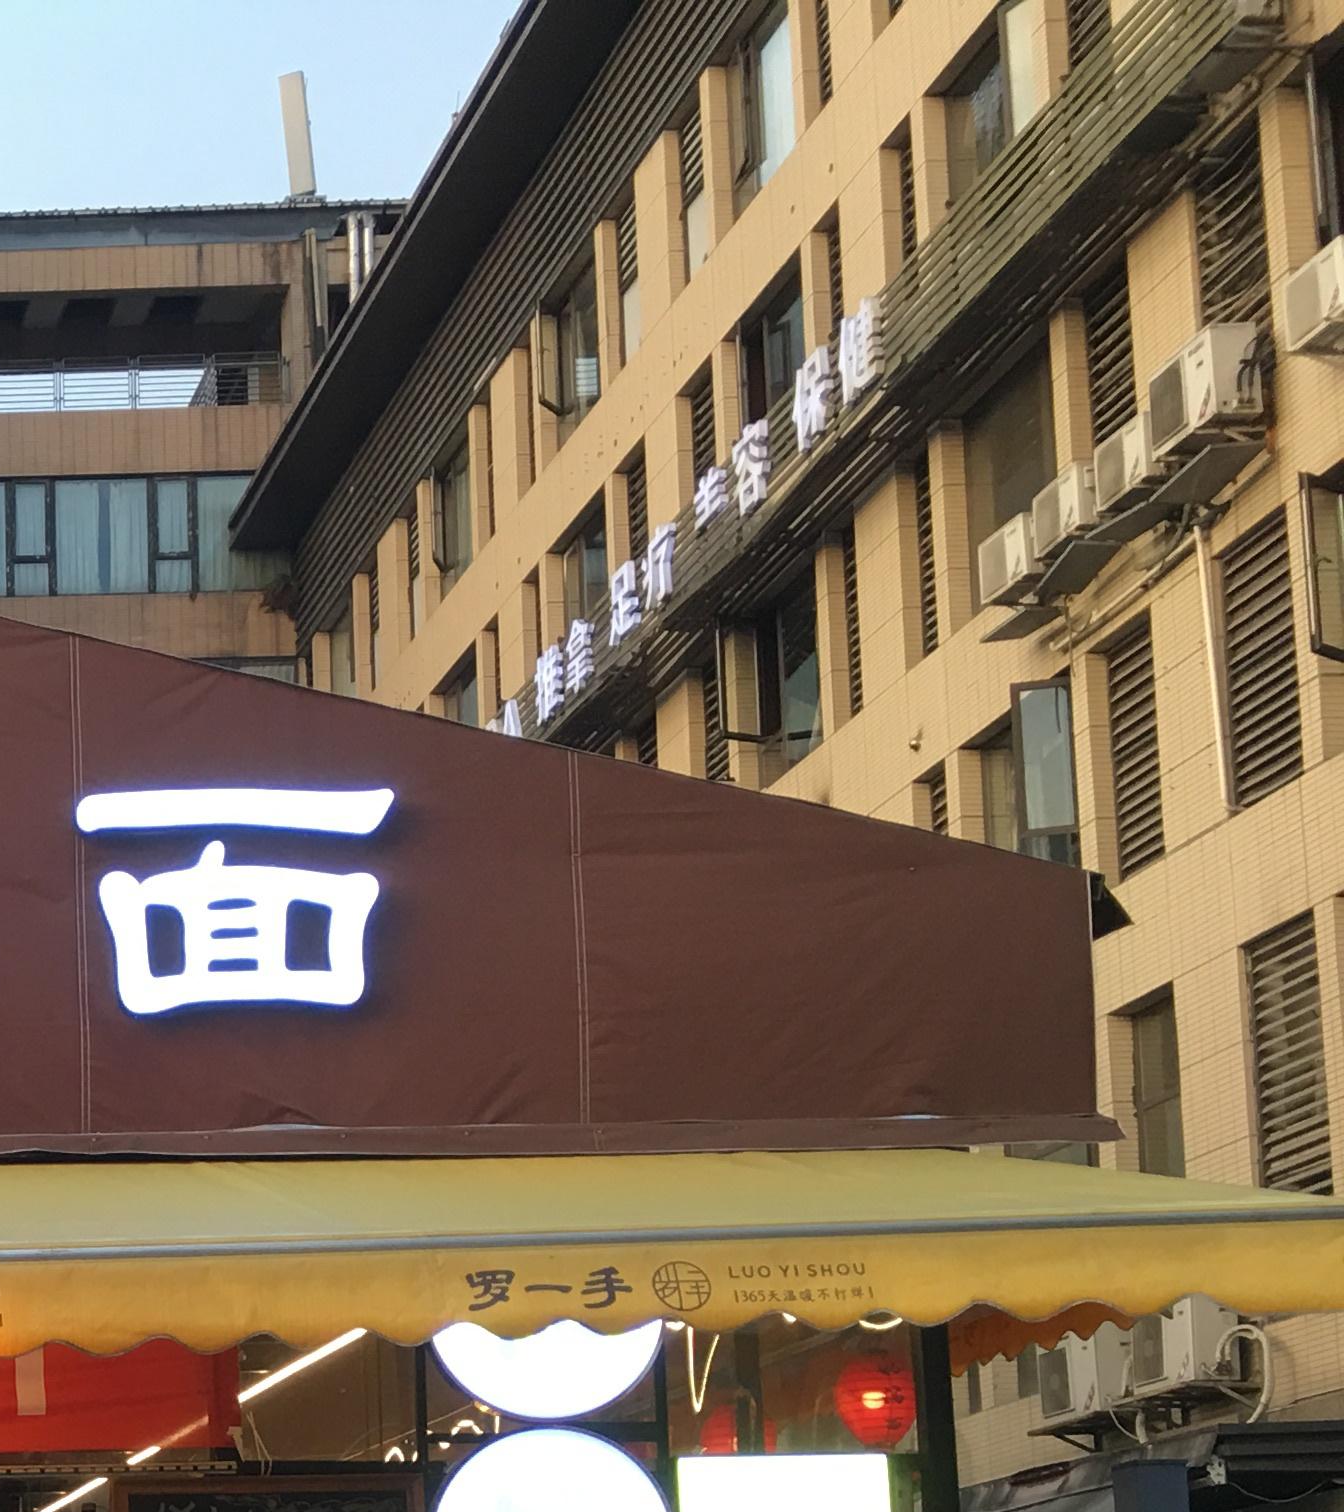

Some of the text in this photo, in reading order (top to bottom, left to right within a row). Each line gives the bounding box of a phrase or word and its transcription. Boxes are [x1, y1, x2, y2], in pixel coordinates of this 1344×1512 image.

[793, 296, 888, 455] 保健
[608, 522, 678, 647] 足疗
[534, 617, 596, 727] 推拿
[465, 1265, 633, 1312] 罗一手
[728, 1262, 867, 1279] LUO YI SHOU
